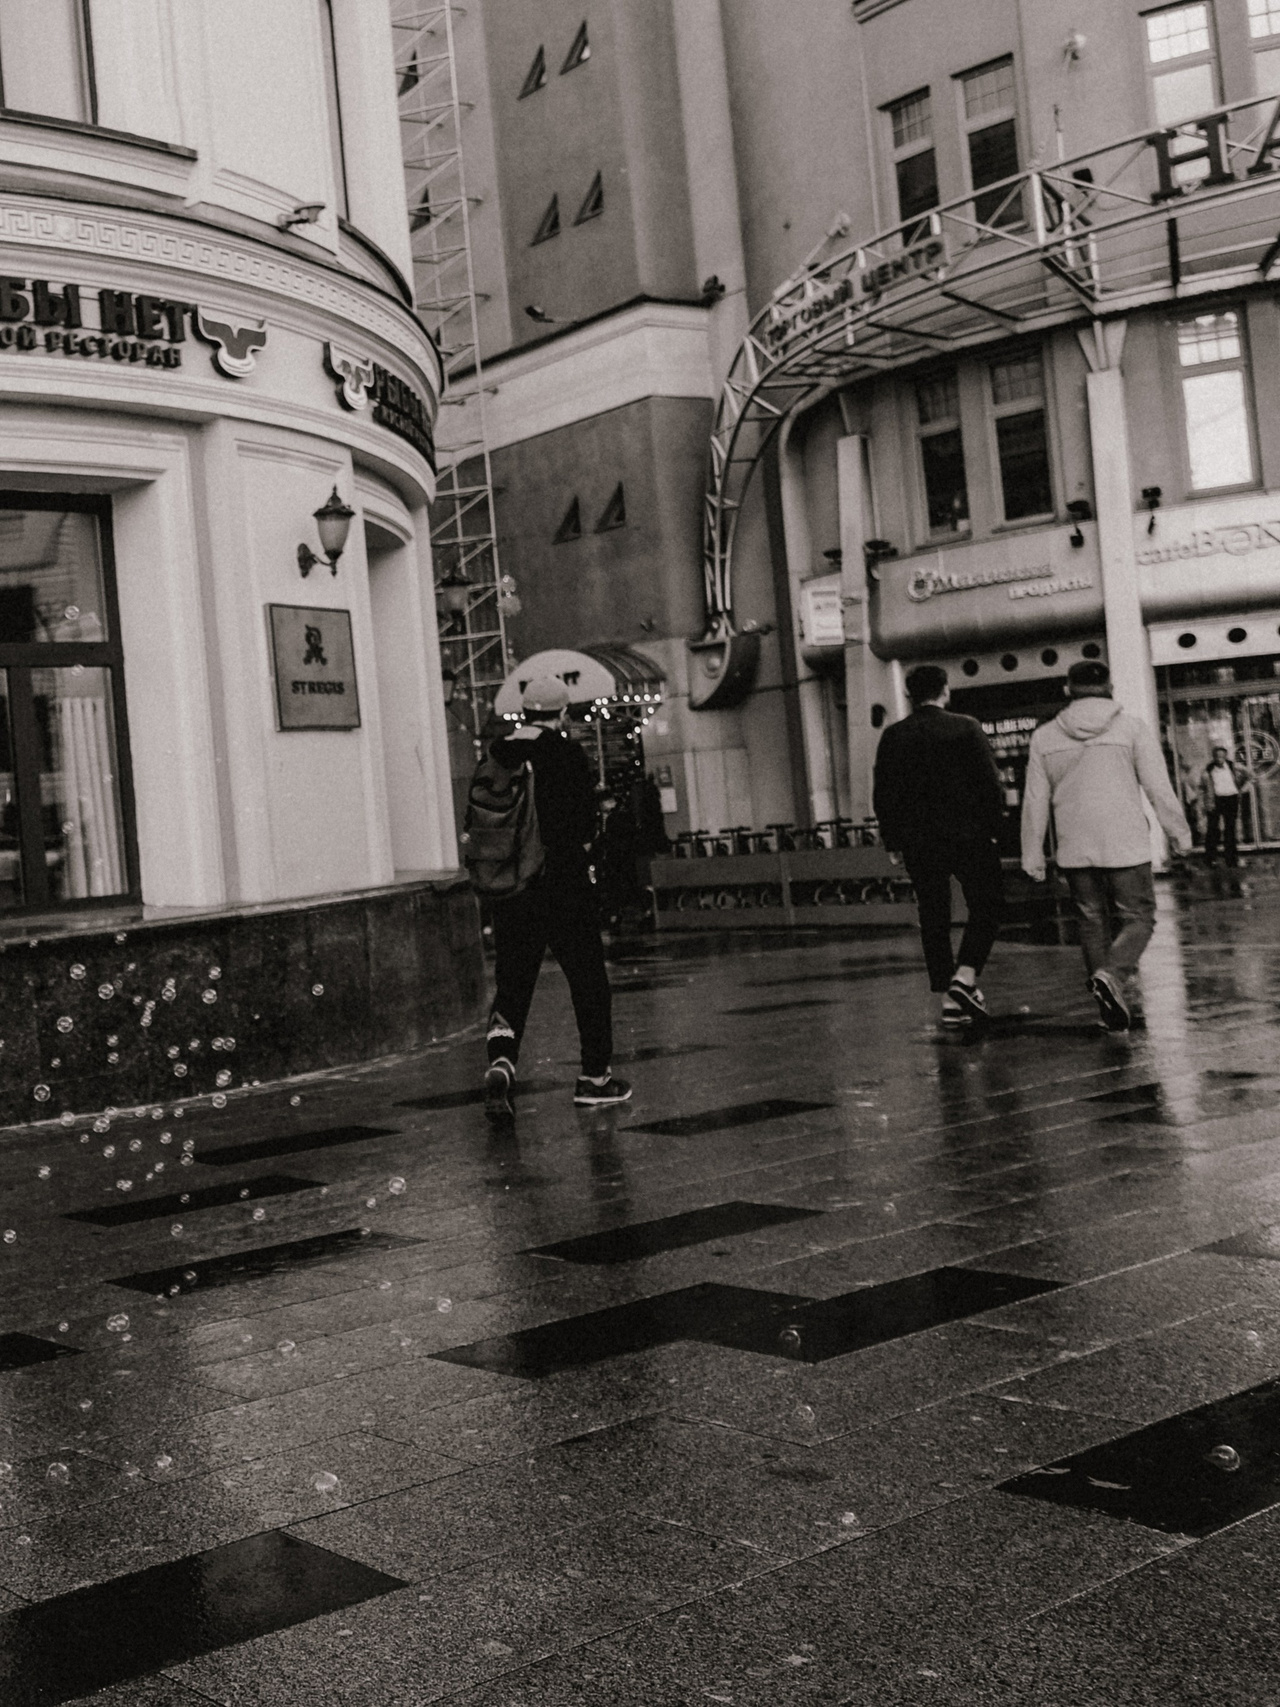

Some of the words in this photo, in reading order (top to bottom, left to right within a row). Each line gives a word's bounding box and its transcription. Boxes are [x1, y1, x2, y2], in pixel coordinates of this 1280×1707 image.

[861, 241, 943, 298] ЦЕНТР
[96, 287, 196, 344] НЕТ
[44, 331, 183, 369] РЕСТОРАН
